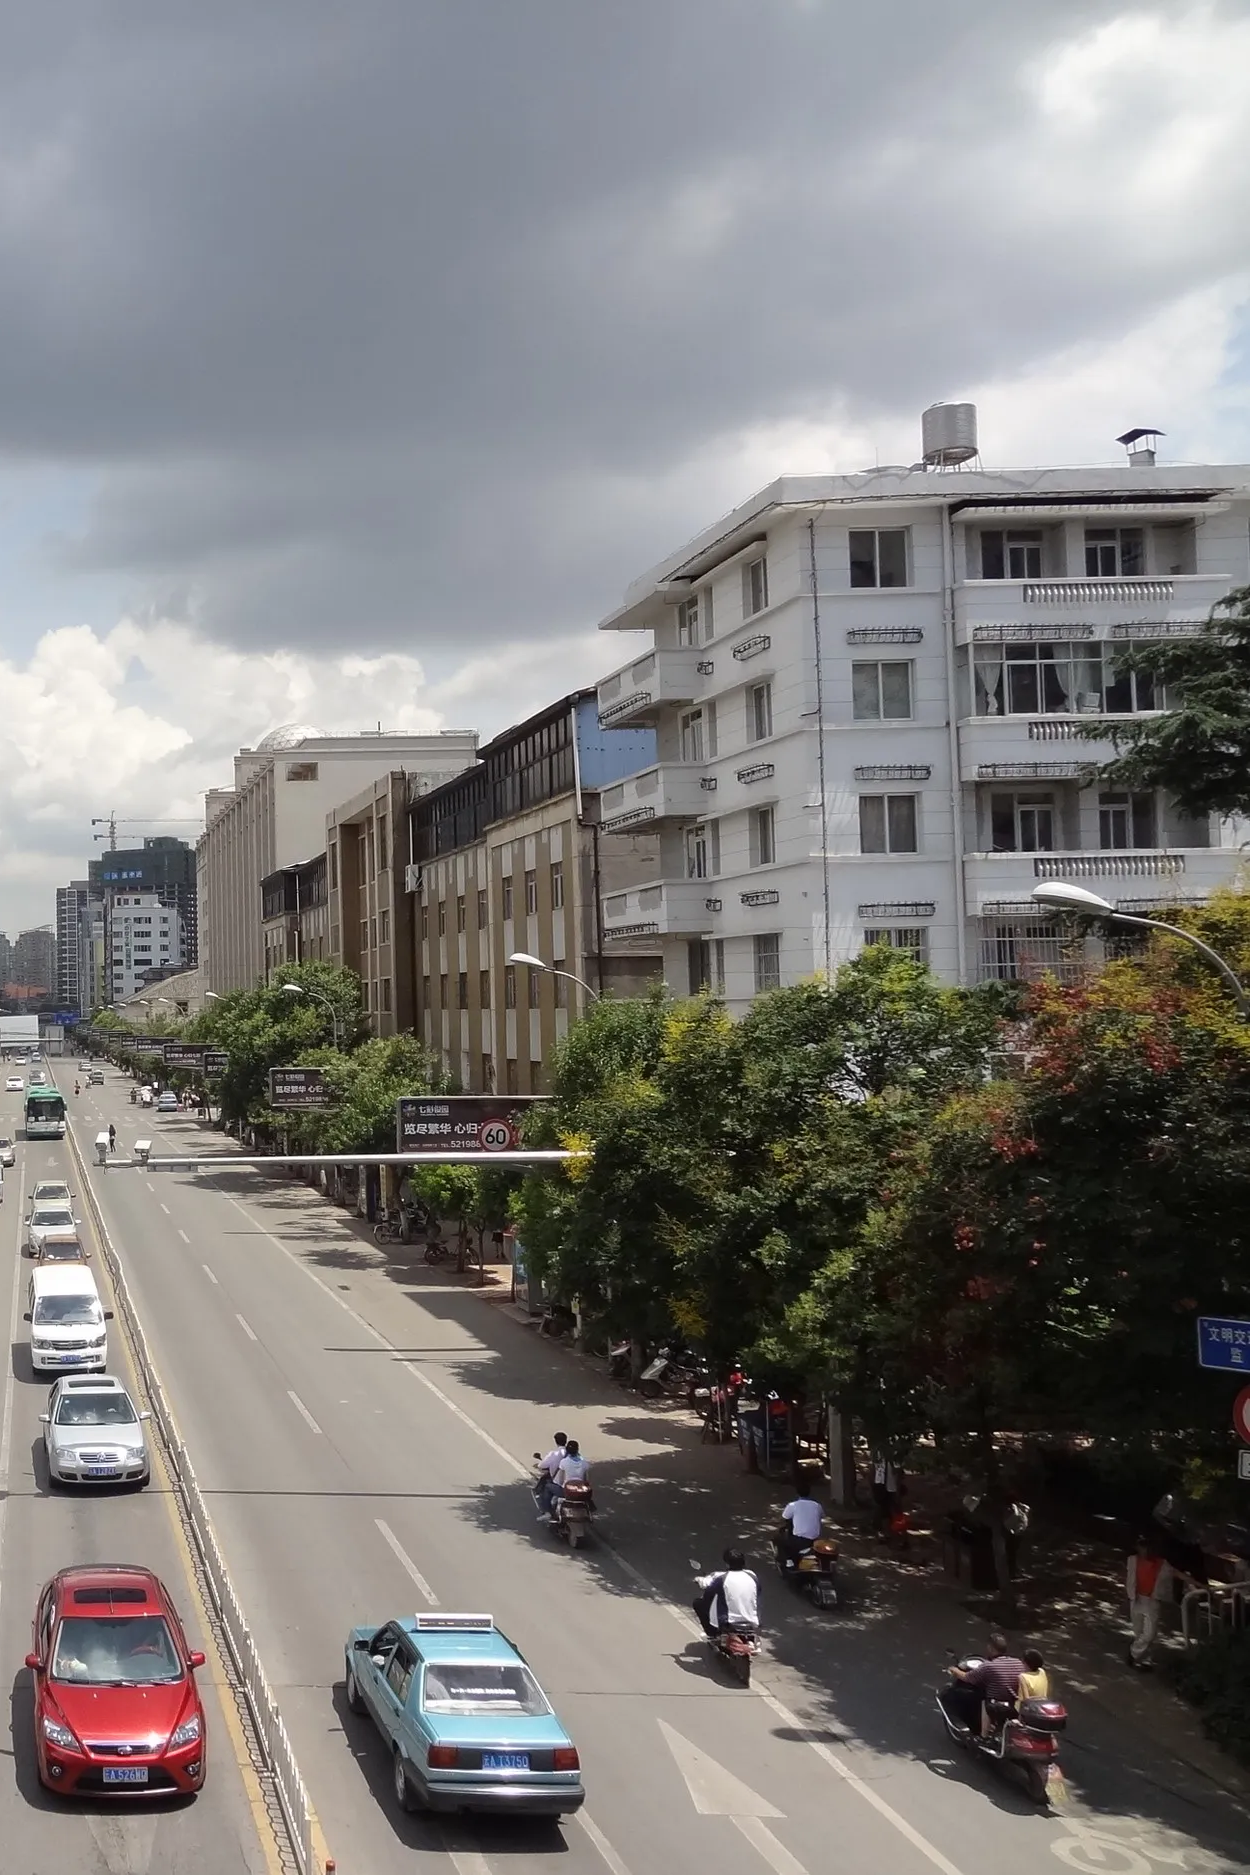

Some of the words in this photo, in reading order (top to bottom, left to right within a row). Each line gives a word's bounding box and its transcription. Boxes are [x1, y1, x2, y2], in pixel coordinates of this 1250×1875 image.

[404, 1122, 451, 1135] 览尽繁华
[454, 1122, 484, 1134] 心归
[485, 1128, 506, 1145] 60
